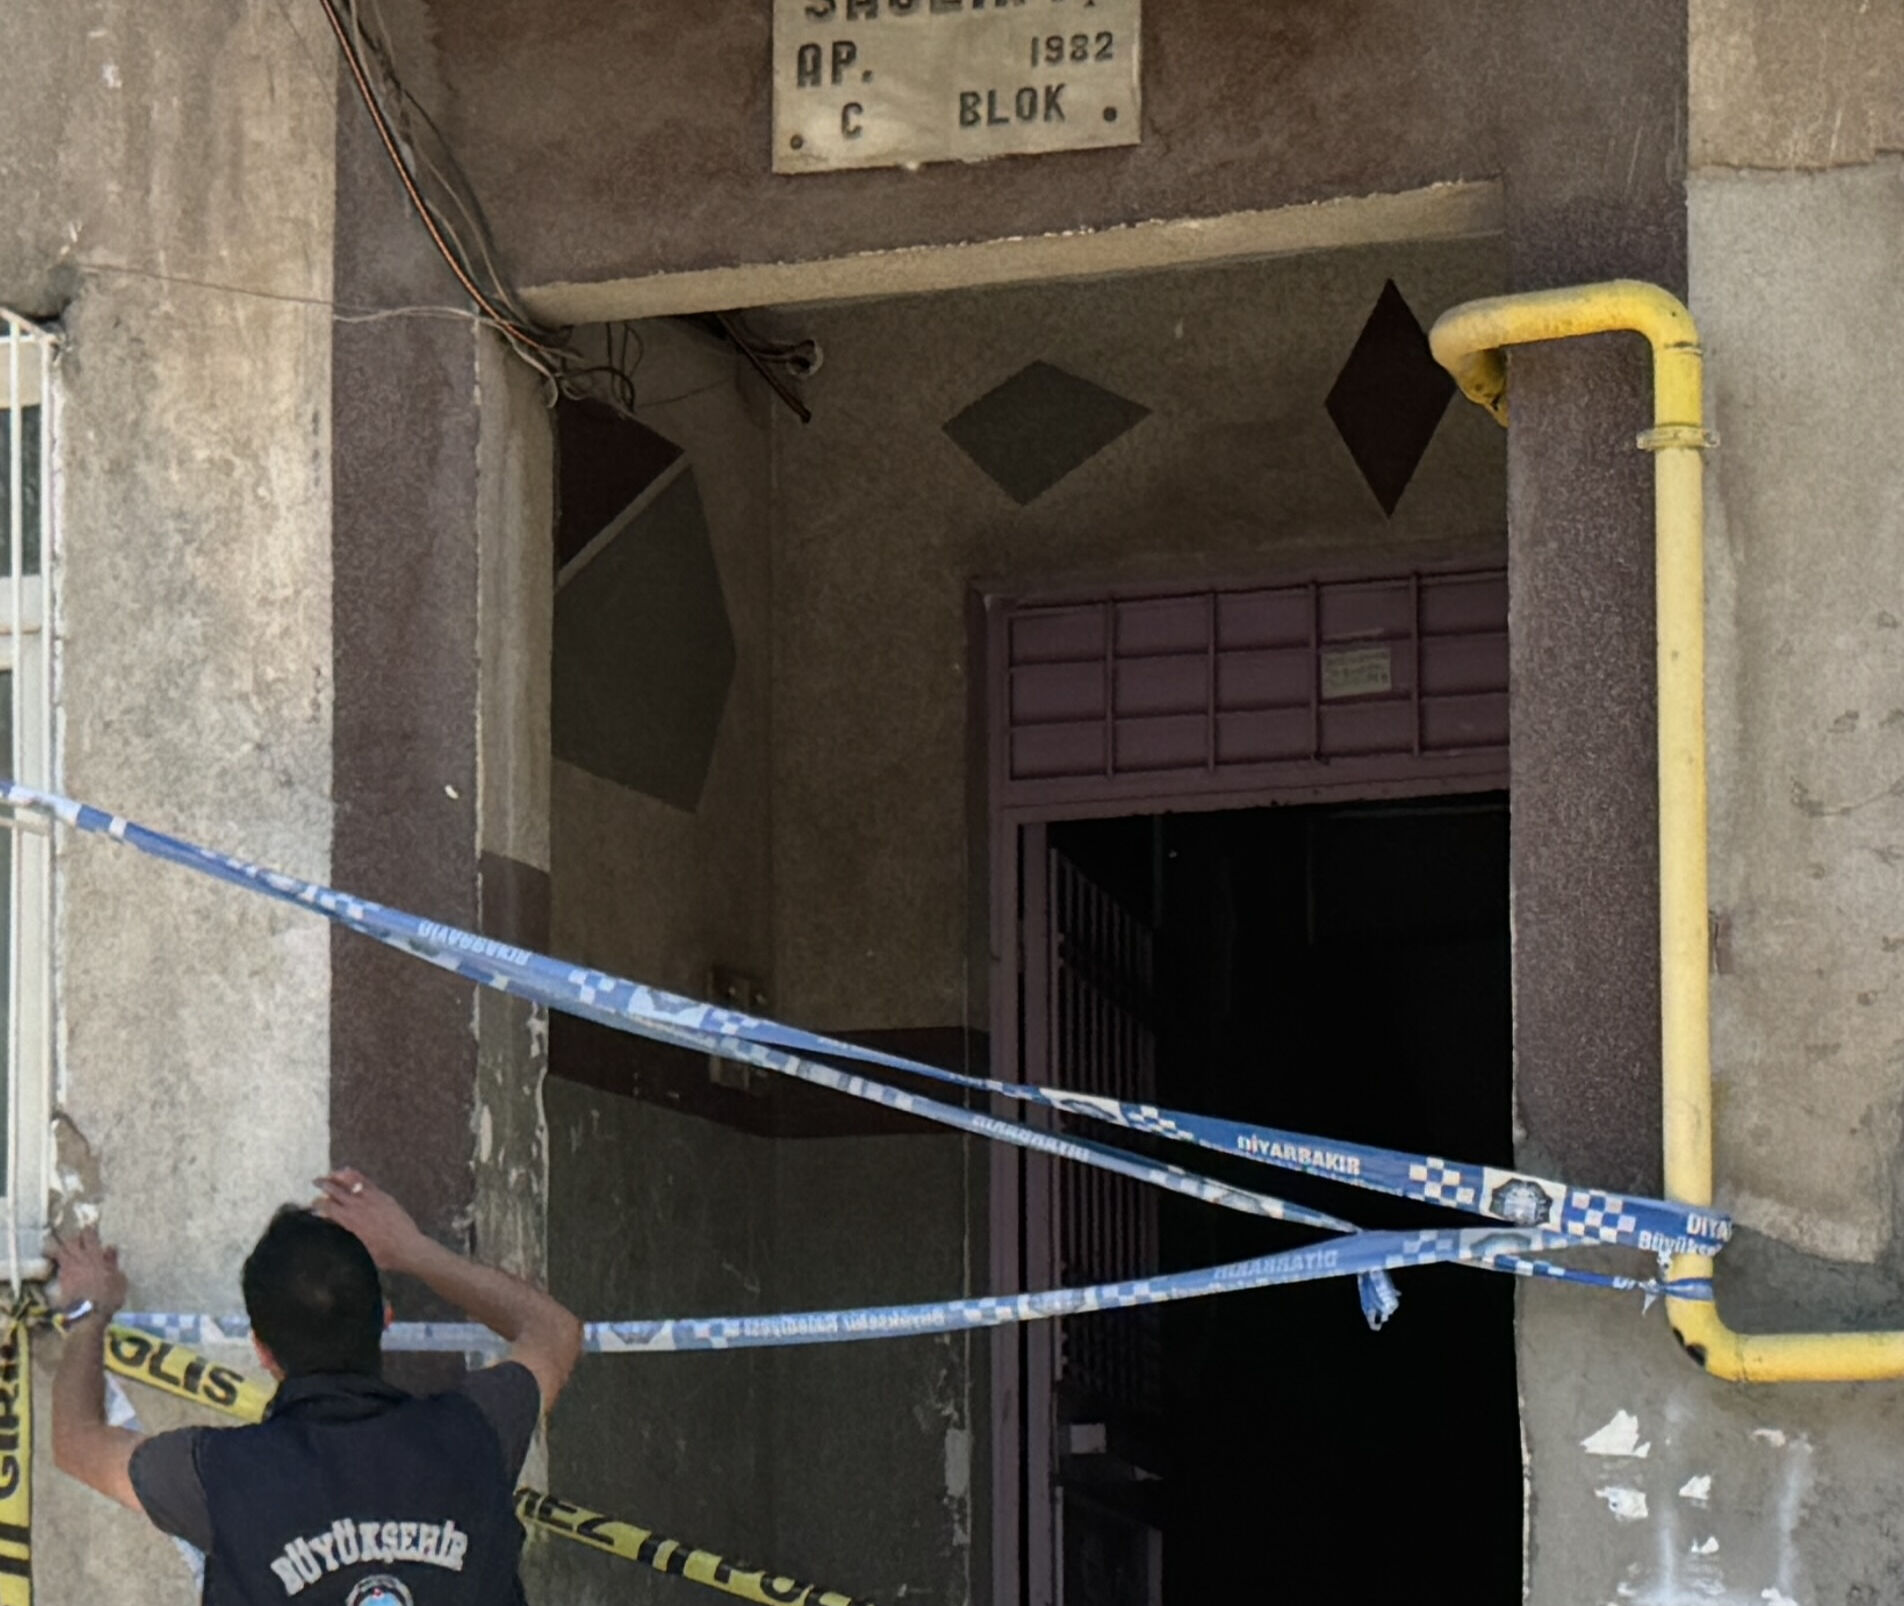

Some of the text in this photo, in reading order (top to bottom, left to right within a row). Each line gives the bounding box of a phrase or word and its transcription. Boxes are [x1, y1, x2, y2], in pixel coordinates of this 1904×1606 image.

[796, 31, 1115, 88] AP. 1982
[840, 83, 1067, 140] C BLOK
[270, 1518, 469, 1596] BÜYÜKŞEHİR
